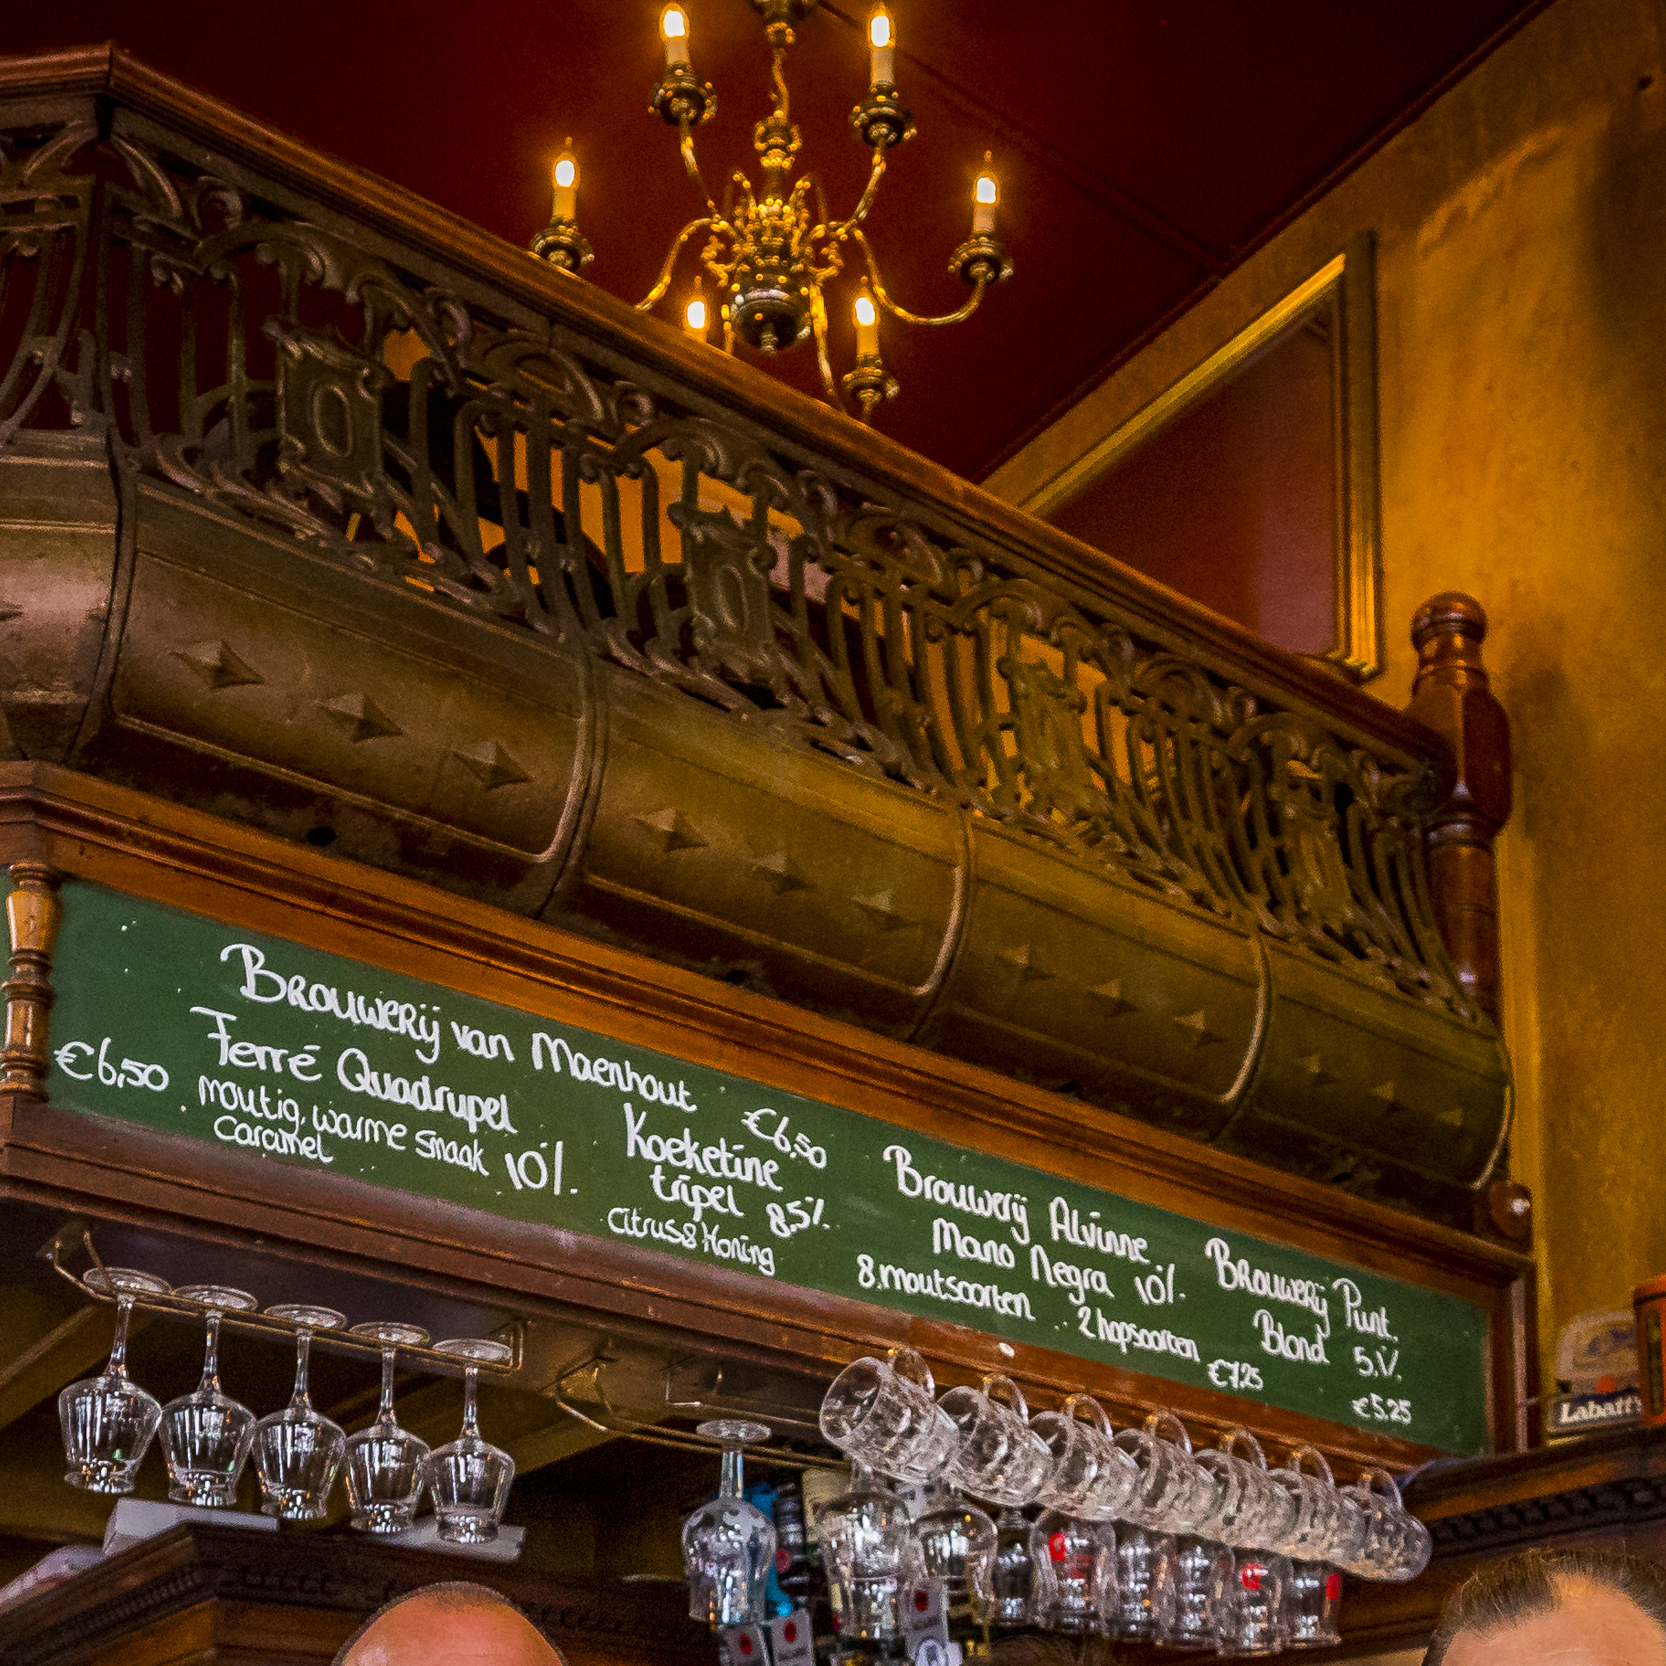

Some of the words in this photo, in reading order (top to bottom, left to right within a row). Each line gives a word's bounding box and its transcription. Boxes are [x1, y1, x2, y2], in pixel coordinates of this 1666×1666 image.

[220, 943, 441, 1064] Brouwerij
[451, 1020, 516, 1062] van
[532, 1031, 698, 1113] Maenhout
[336, 1048, 519, 1134] Quadrupel
[313, 1103, 407, 1150] warme
[414, 1128, 491, 1177] smaak
[650, 1165, 745, 1222] tripel
[883, 1145, 1031, 1245] Brouwerij
[1049, 1196, 1151, 1265] Alvinne
[933, 1217, 1015, 1269] Mano
[1031, 1244, 1116, 1306] Negra
[1205, 1237, 1332, 1340] Brouwerij
[1252, 1308, 1331, 1365] Blond
